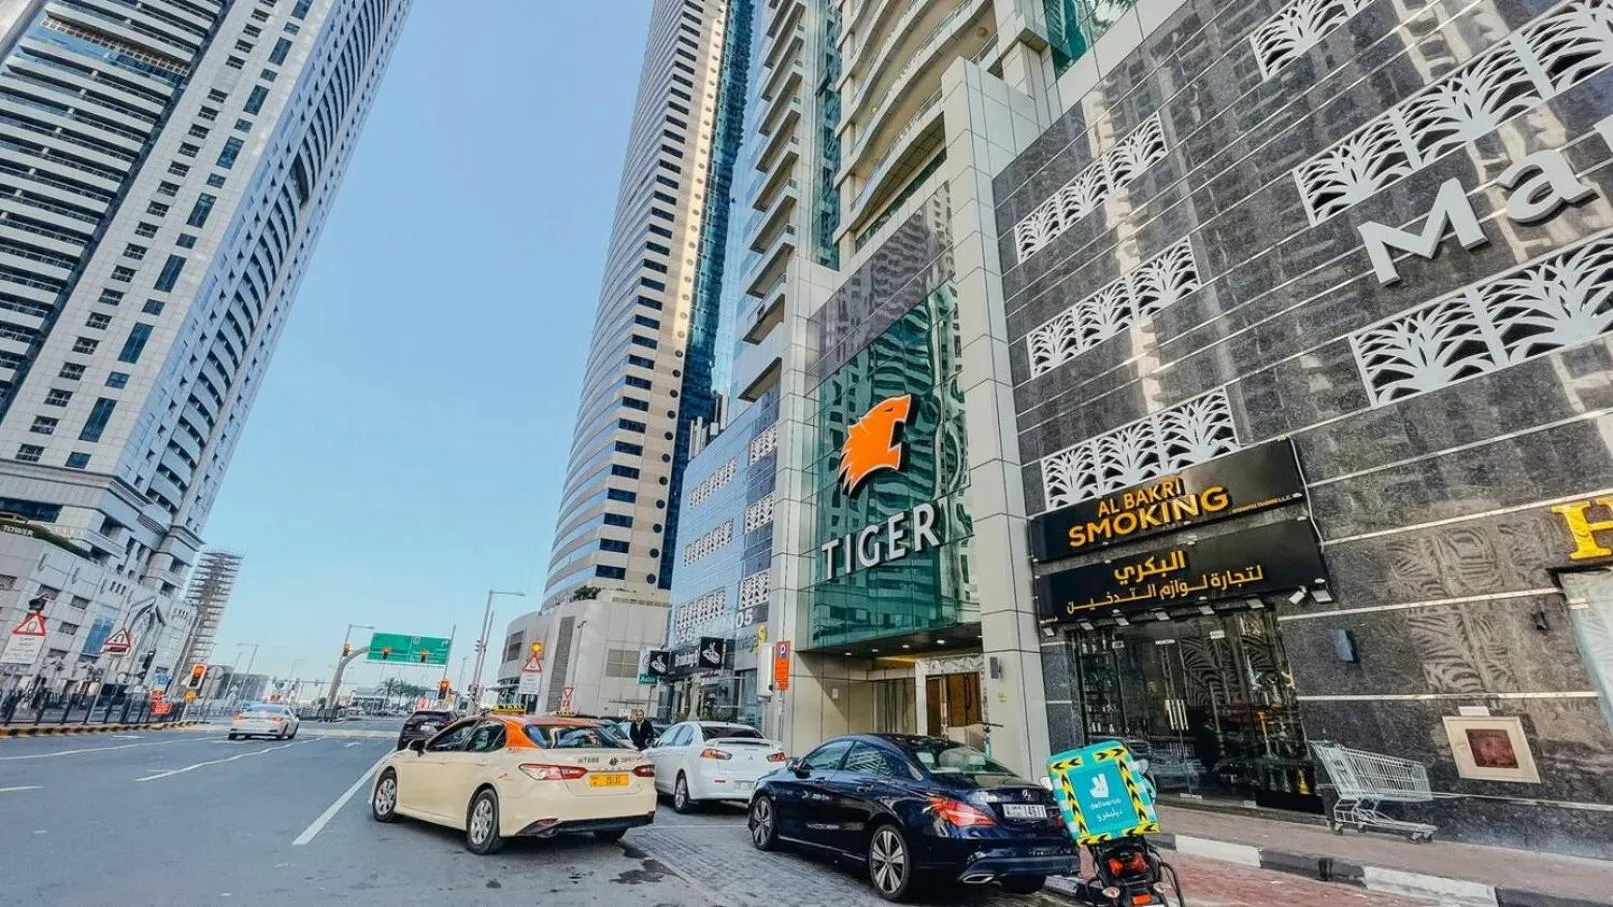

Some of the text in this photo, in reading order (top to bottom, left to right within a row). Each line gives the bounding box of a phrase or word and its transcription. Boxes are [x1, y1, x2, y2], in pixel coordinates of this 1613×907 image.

[1357, 114, 1613, 288] Ma
[1069, 486, 1229, 546] SMOKING
[1098, 477, 1184, 518] AL BAKRI
[821, 502, 940, 580] TIGER
[1114, 551, 1186, 586] البكري
[1210, 564, 1264, 592] لتجارة
